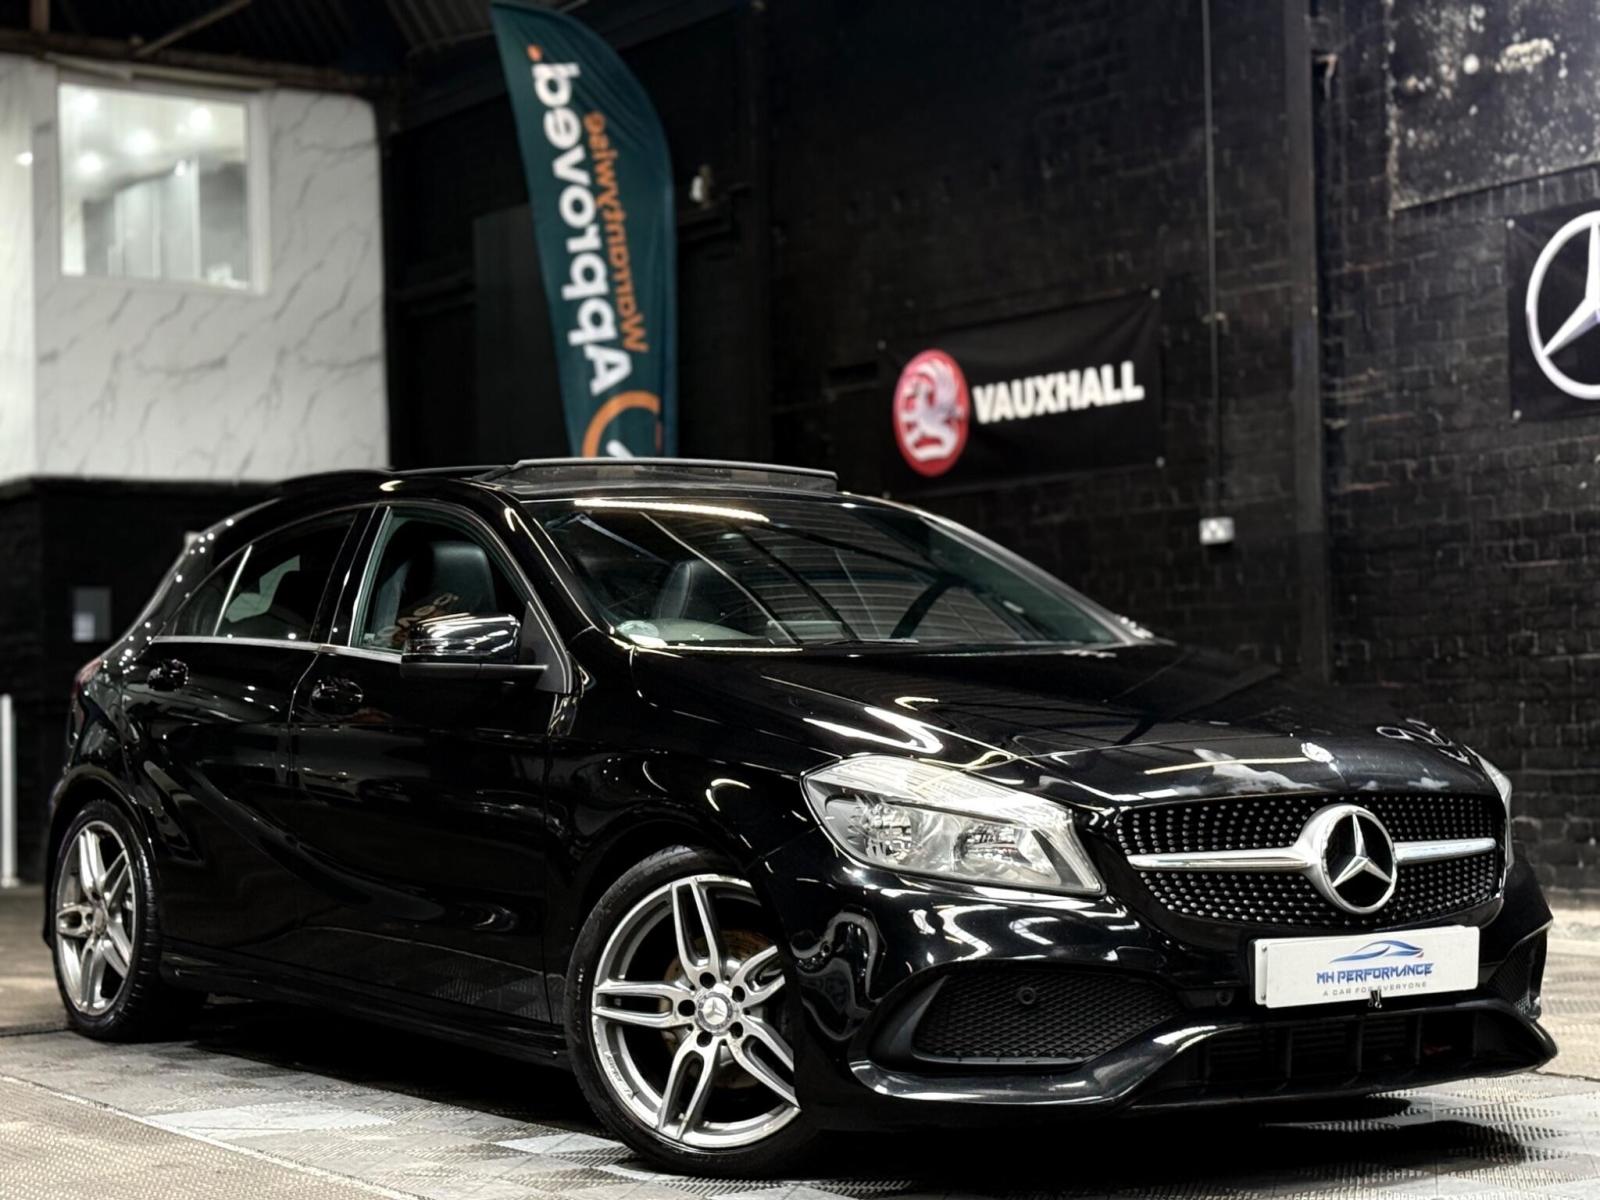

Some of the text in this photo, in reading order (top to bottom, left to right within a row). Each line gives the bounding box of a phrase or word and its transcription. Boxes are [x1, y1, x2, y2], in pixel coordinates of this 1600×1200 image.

[972, 360, 1145, 425] VAUXHALL
[1316, 963, 1434, 984] MH PERFORMANCE
[1332, 988, 1352, 996] CAR
